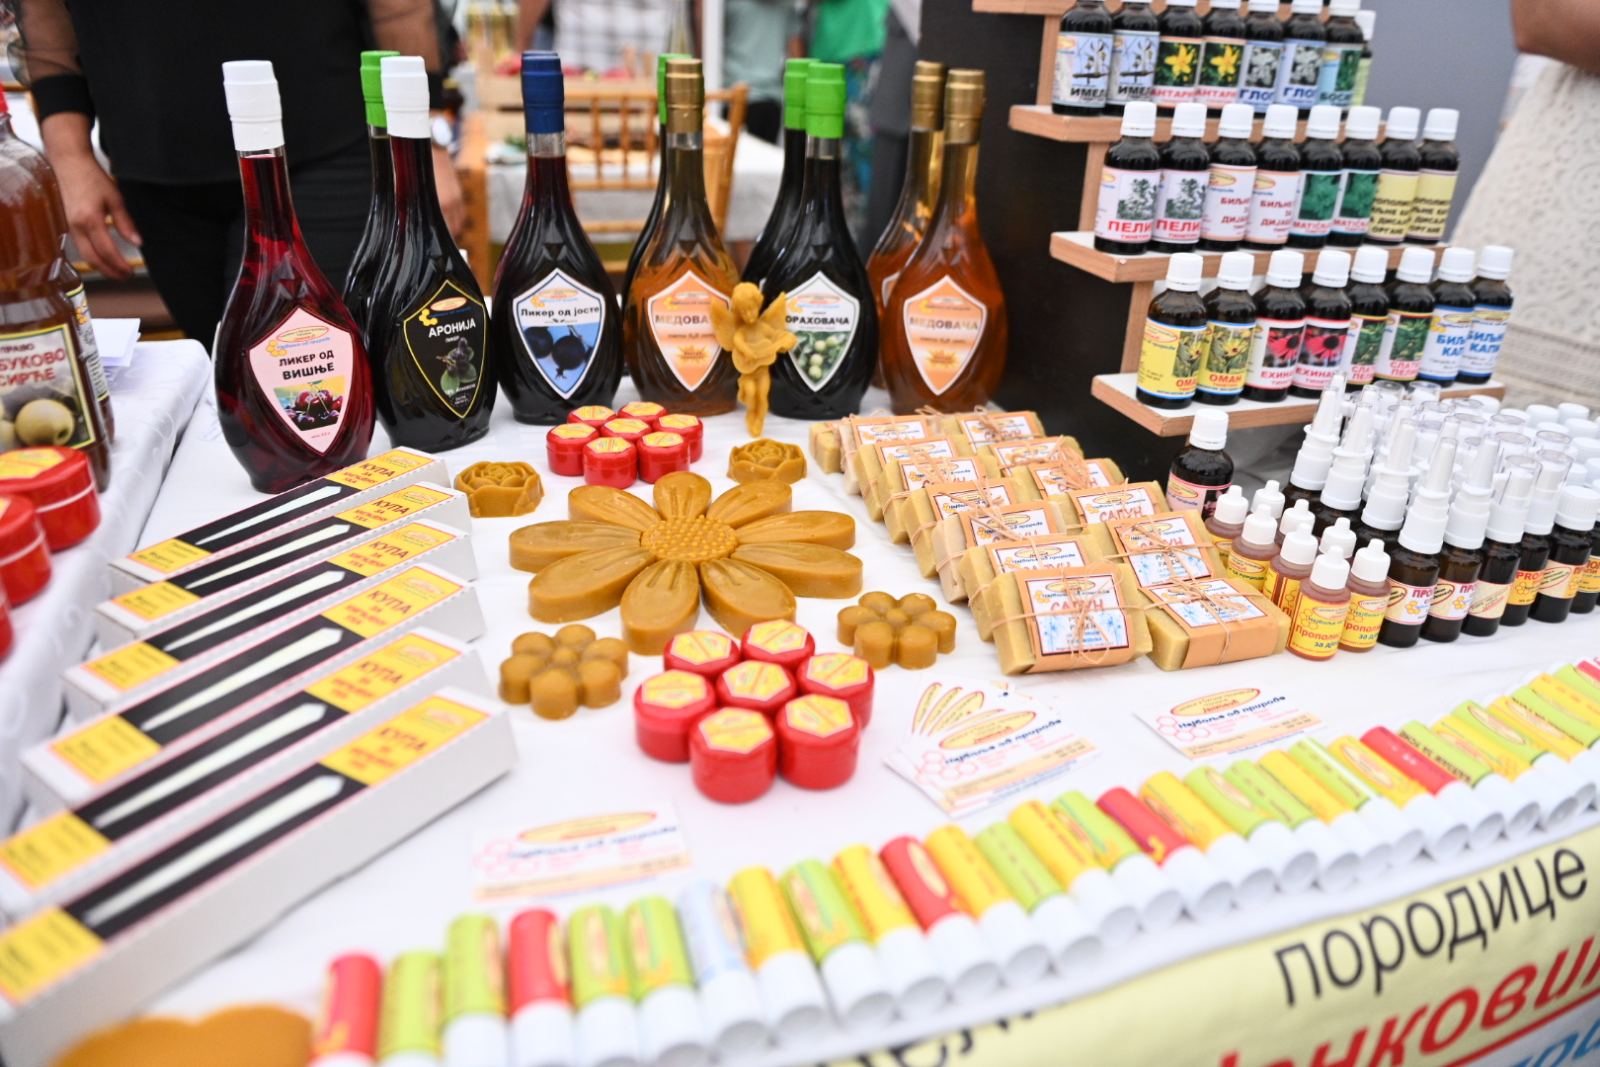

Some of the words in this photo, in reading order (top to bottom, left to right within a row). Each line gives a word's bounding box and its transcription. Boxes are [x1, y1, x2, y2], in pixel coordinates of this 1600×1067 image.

[1240, 89, 1273, 101] ГЛО
[1283, 87, 1316, 99] ГЛО
[1108, 220, 1152, 233] ПЕЛИ
[1156, 219, 1200, 232] ПЕЛИ
[521, 308, 554, 318] Ликер
[558, 308, 571, 317] од
[573, 305, 600, 317] јосте
[655, 315, 709, 326] МЕДОВА
[785, 315, 849, 325] ОРАХОВАЧА
[428, 318, 476, 339] АРОНИЈА
[1470, 342, 1500, 353] КАП
[279, 353, 316, 367] ЛИКЕР
[319, 349, 334, 360] ОД
[282, 362, 334, 381] ВИШЊЕ
[1295, 366, 1333, 377] ЕХИНА
[1175, 376, 1198, 388] ОМА
[1209, 373, 1242, 384] ОМАН
[361, 463, 395, 477] КУПА
[373, 500, 410, 515] КУПА
[1100, 505, 1143, 522] САПУН
[369, 541, 409, 558] КУПА
[1516, 572, 1543, 580] PRO
[1412, 588, 1435, 598] ПРО
[367, 590, 412, 614] КУПА
[1273, 848, 1588, 1008] породице
